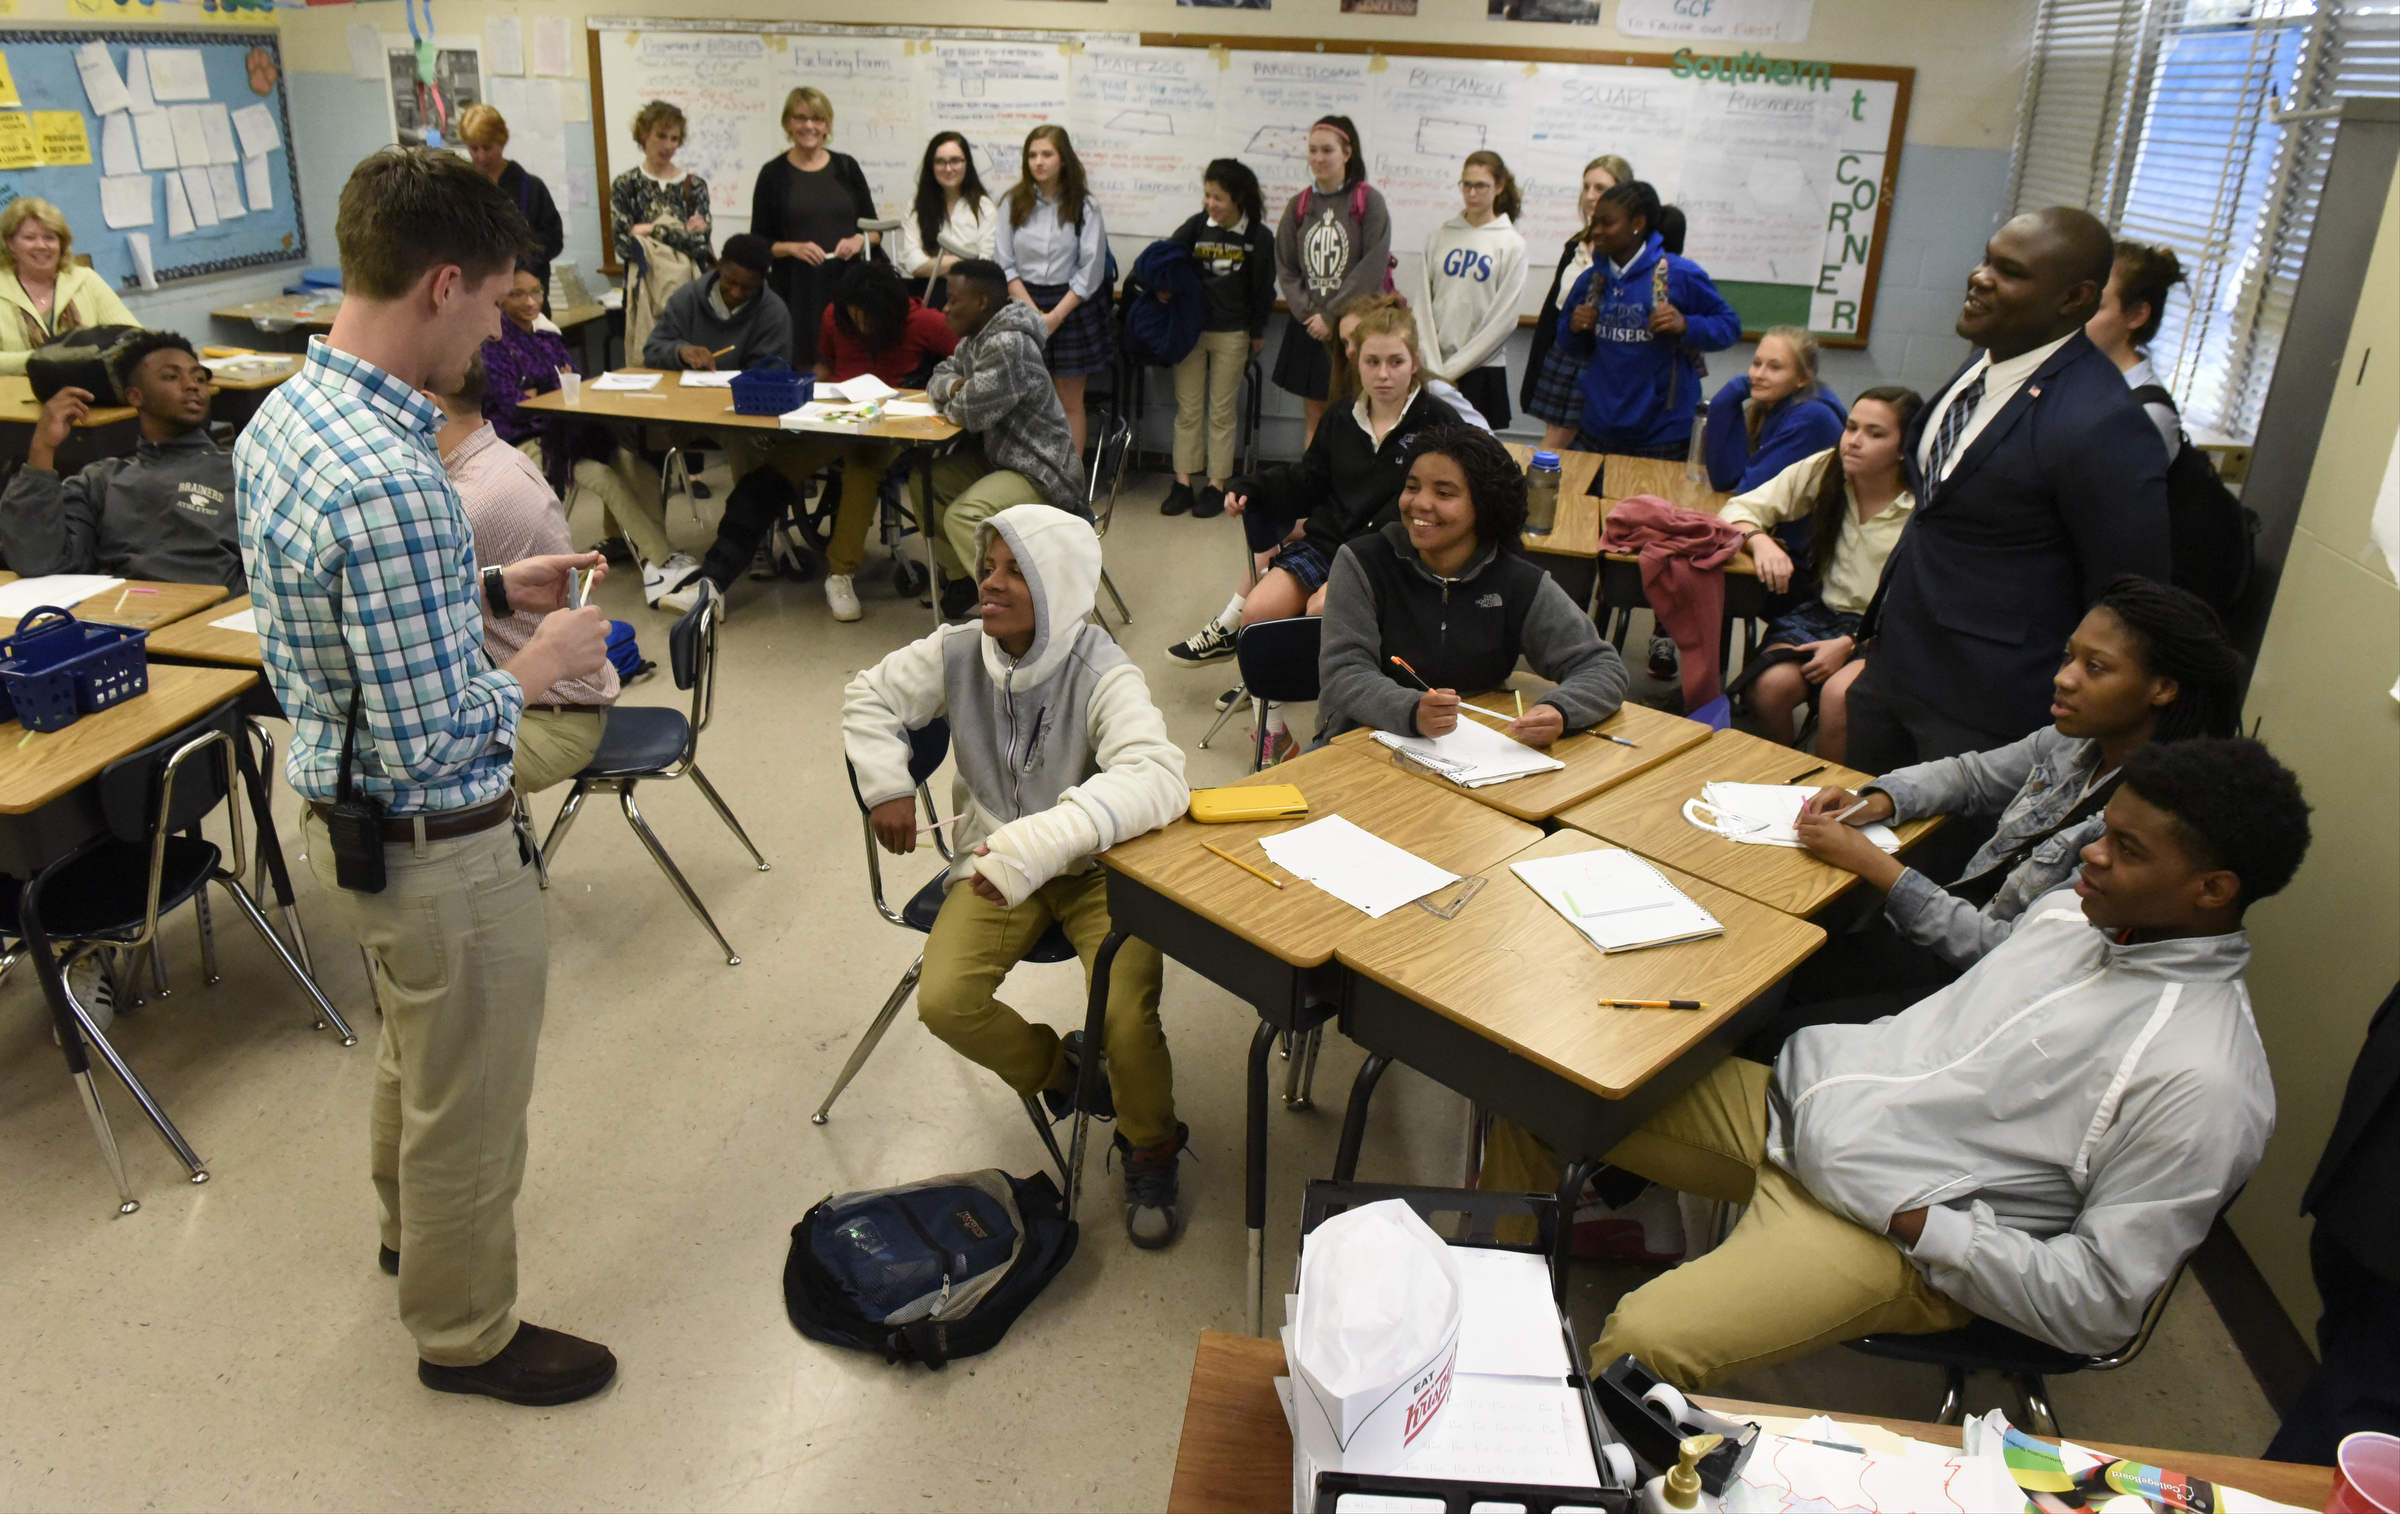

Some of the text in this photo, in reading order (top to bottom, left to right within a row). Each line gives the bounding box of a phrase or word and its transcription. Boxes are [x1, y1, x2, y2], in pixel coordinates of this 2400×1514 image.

[1674, 0, 1713, 17] GCF
[1670, 47, 1832, 92] Southern
[1310, 226, 1341, 277] GPS
[1443, 248, 1493, 283] GPS
[178, 482, 225, 504] BRAINERD
[1413, 1370, 1435, 1396] EAT
[2111, 1470, 2182, 1494] CollegeBoard
